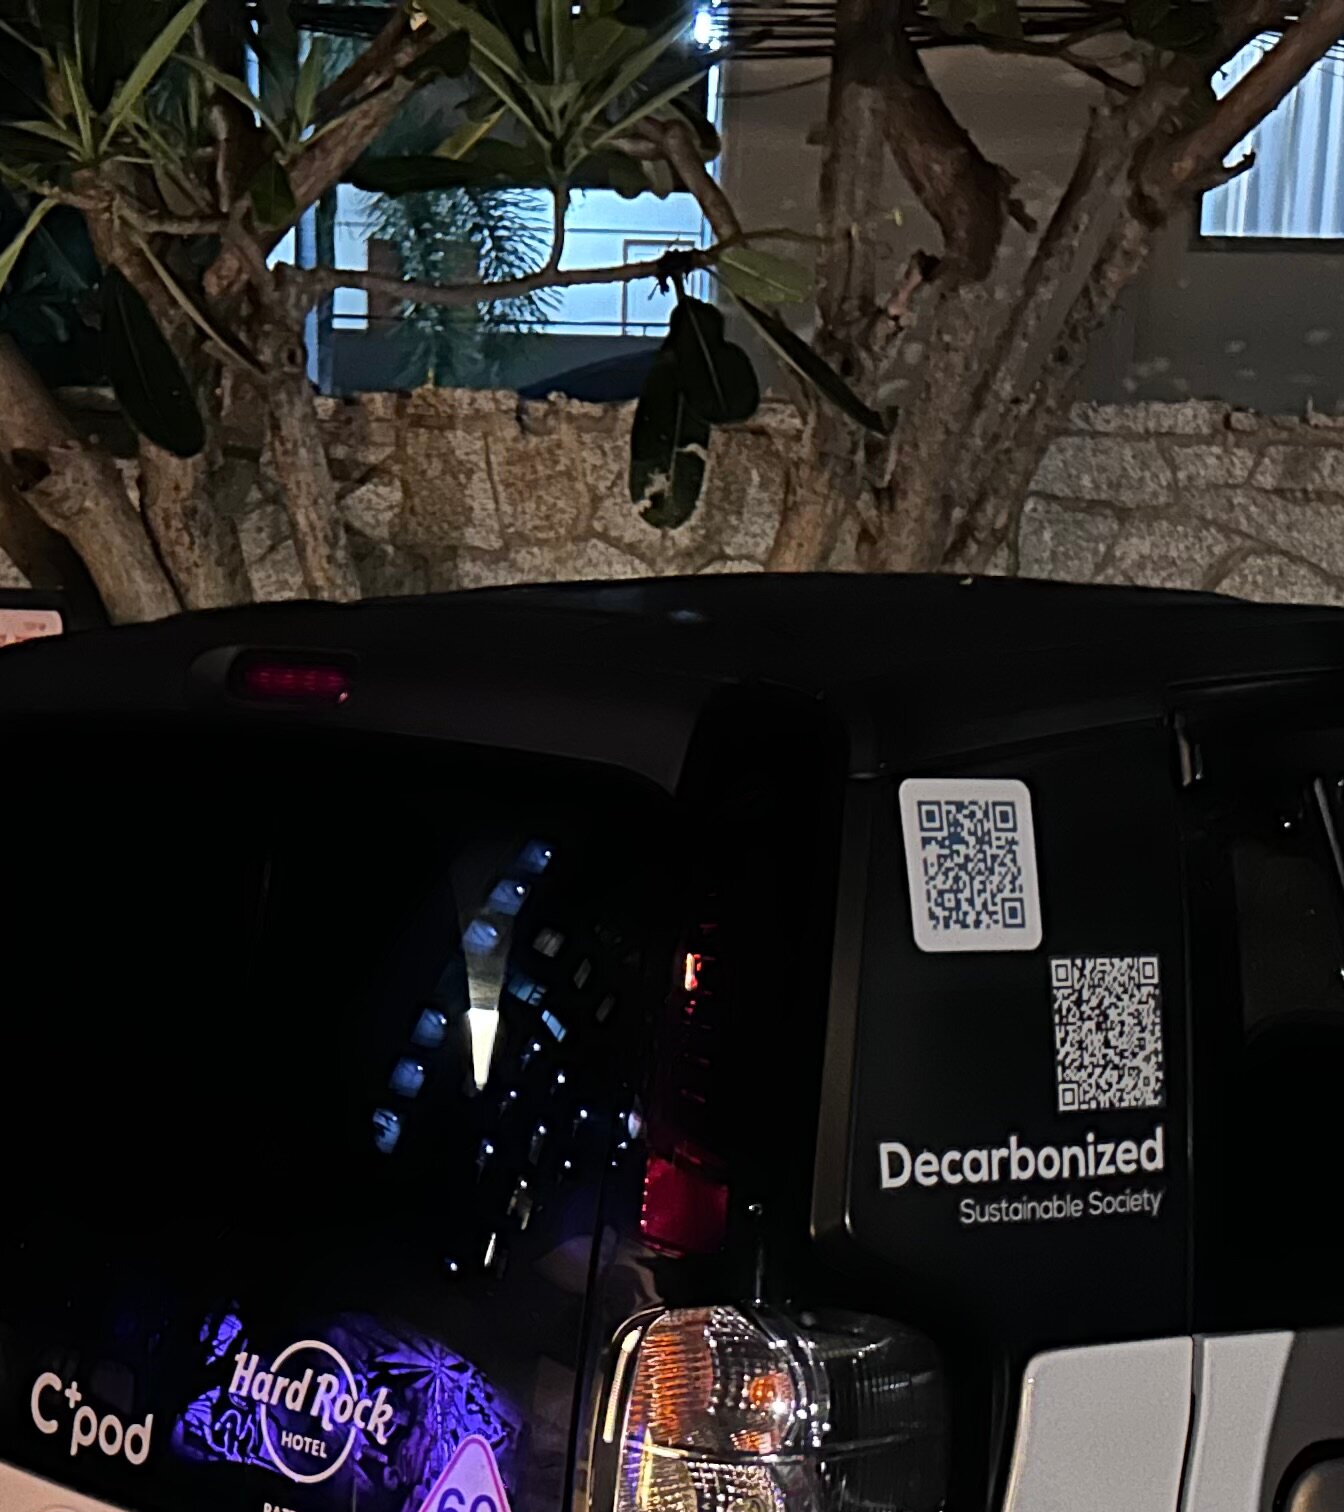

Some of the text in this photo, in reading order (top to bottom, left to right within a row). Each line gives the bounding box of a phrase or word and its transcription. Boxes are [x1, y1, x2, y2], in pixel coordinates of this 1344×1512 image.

[878, 1126, 1165, 1190] Decarbonized
[959, 1189, 1163, 1225] Sustainable Society
[228, 1351, 394, 1445] Hard Rock
[280, 1430, 328, 1459] HOTEL
